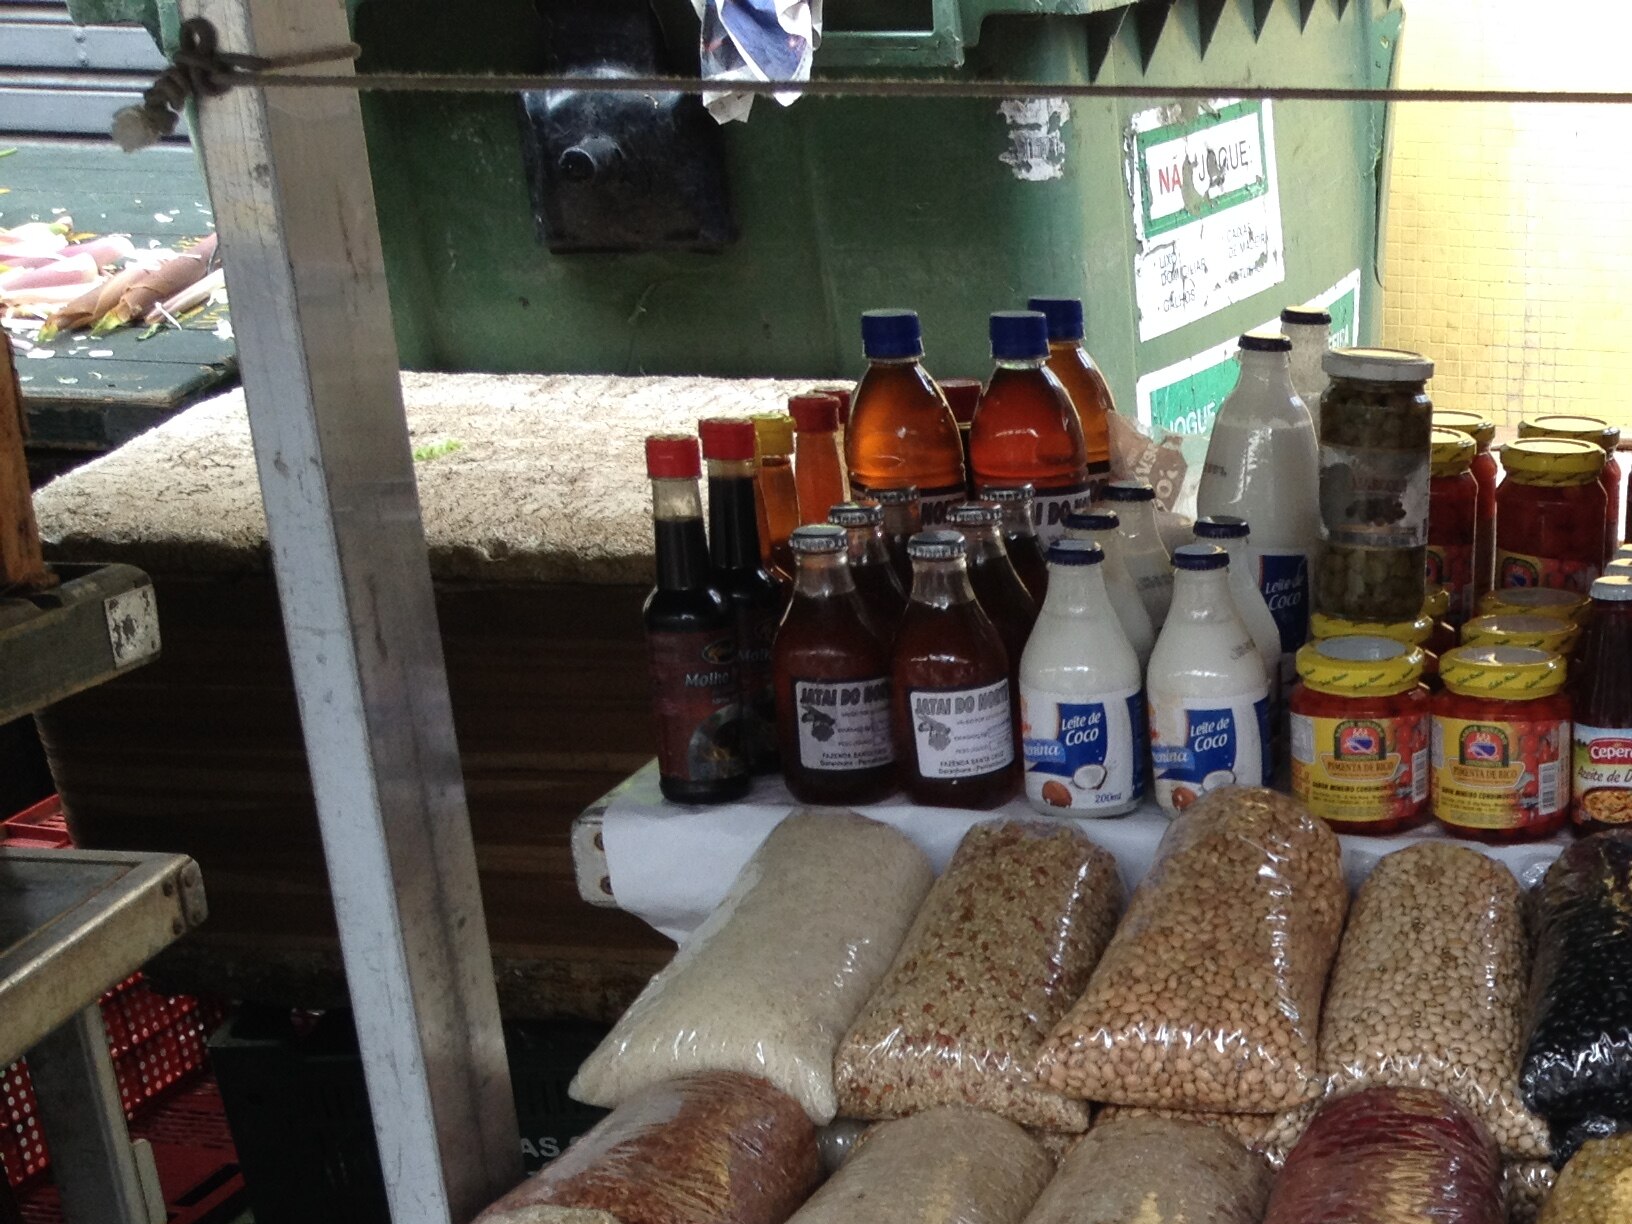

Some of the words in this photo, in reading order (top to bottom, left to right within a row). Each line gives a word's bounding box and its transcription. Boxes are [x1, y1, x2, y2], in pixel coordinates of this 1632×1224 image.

[1158, 154, 1184, 196] NÃ
[1198, 140, 1253, 182] JGUE:
[1268, 591, 1302, 611] Coco
[684, 671, 729, 687] Molho
[800, 687, 838, 706] JATAI
[840, 687, 861, 706] DO
[915, 697, 952, 715] JATAI
[954, 695, 976, 715] DO
[1062, 716, 1087, 731] Leite
[1088, 711, 1102, 726] de
[1190, 721, 1215, 737] Leite
[1216, 717, 1230, 730] de
[1066, 727, 1099, 746] Coco
[1194, 733, 1228, 753] Coco
[1453, 766, 1487, 779] PIMENTA
[1577, 764, 1604, 782] Azeite
[1606, 769, 1621, 783] de
[1095, 792, 1122, 803] 200ml
